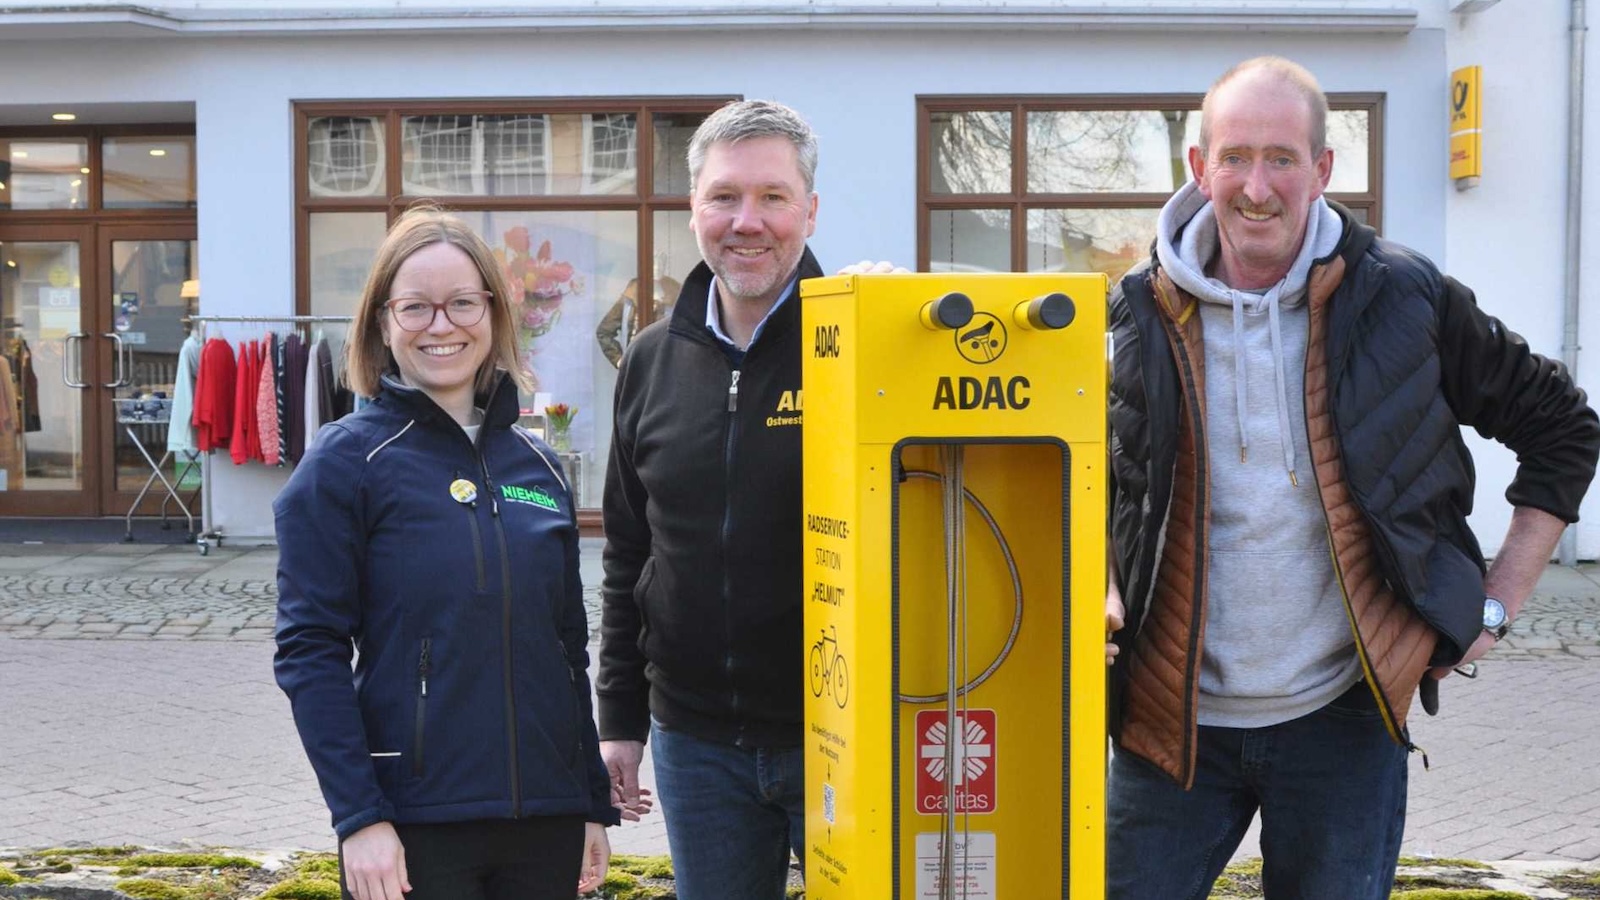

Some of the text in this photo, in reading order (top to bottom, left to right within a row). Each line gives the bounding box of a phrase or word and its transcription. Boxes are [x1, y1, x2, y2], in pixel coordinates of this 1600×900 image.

[814, 325, 840, 358] ADAC
[932, 375, 1031, 411] ADAC
[501, 485, 559, 509] NIEHEIM
[807, 513, 850, 539] RADSERVICE-
[815, 547, 841, 571] STATION
[923, 789, 989, 810] caitas
